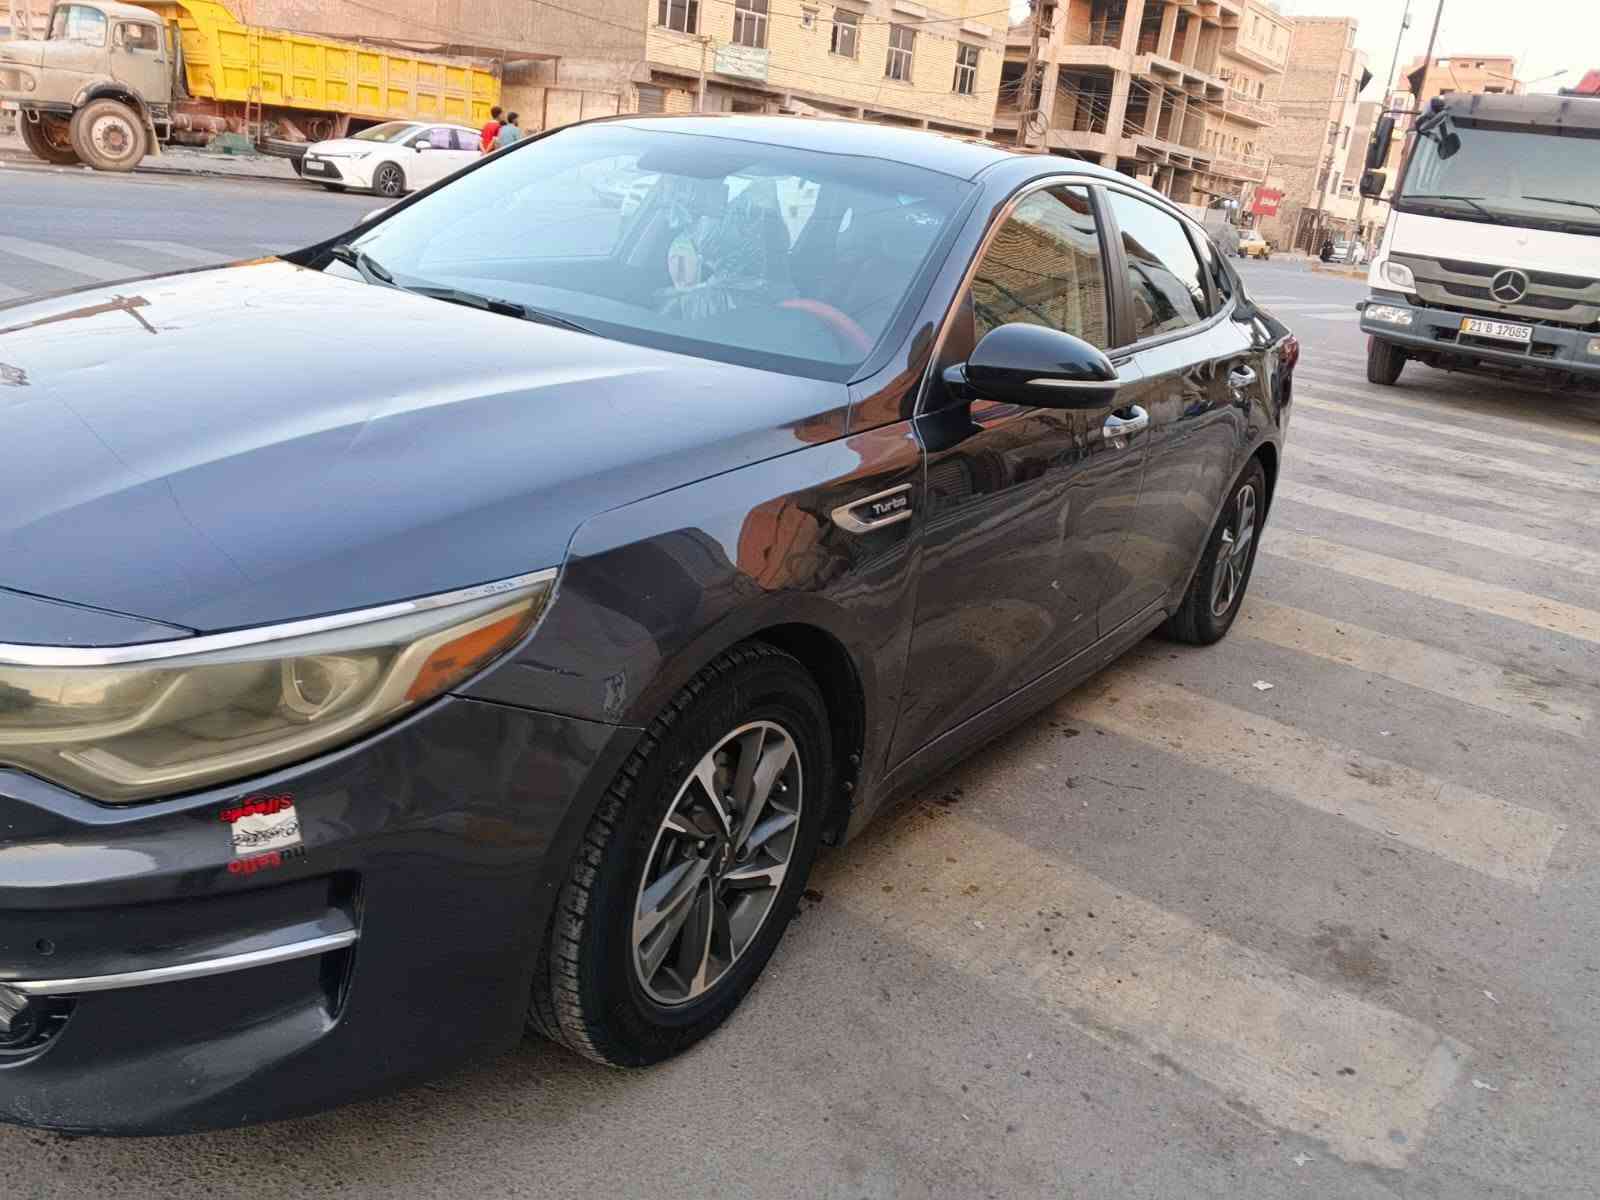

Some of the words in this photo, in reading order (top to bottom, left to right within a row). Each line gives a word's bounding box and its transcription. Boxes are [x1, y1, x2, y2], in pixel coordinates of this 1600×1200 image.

[1471, 320, 1481, 332] 21
[1495, 325, 1529, 338] 17085
[872, 496, 907, 514] Turbo
